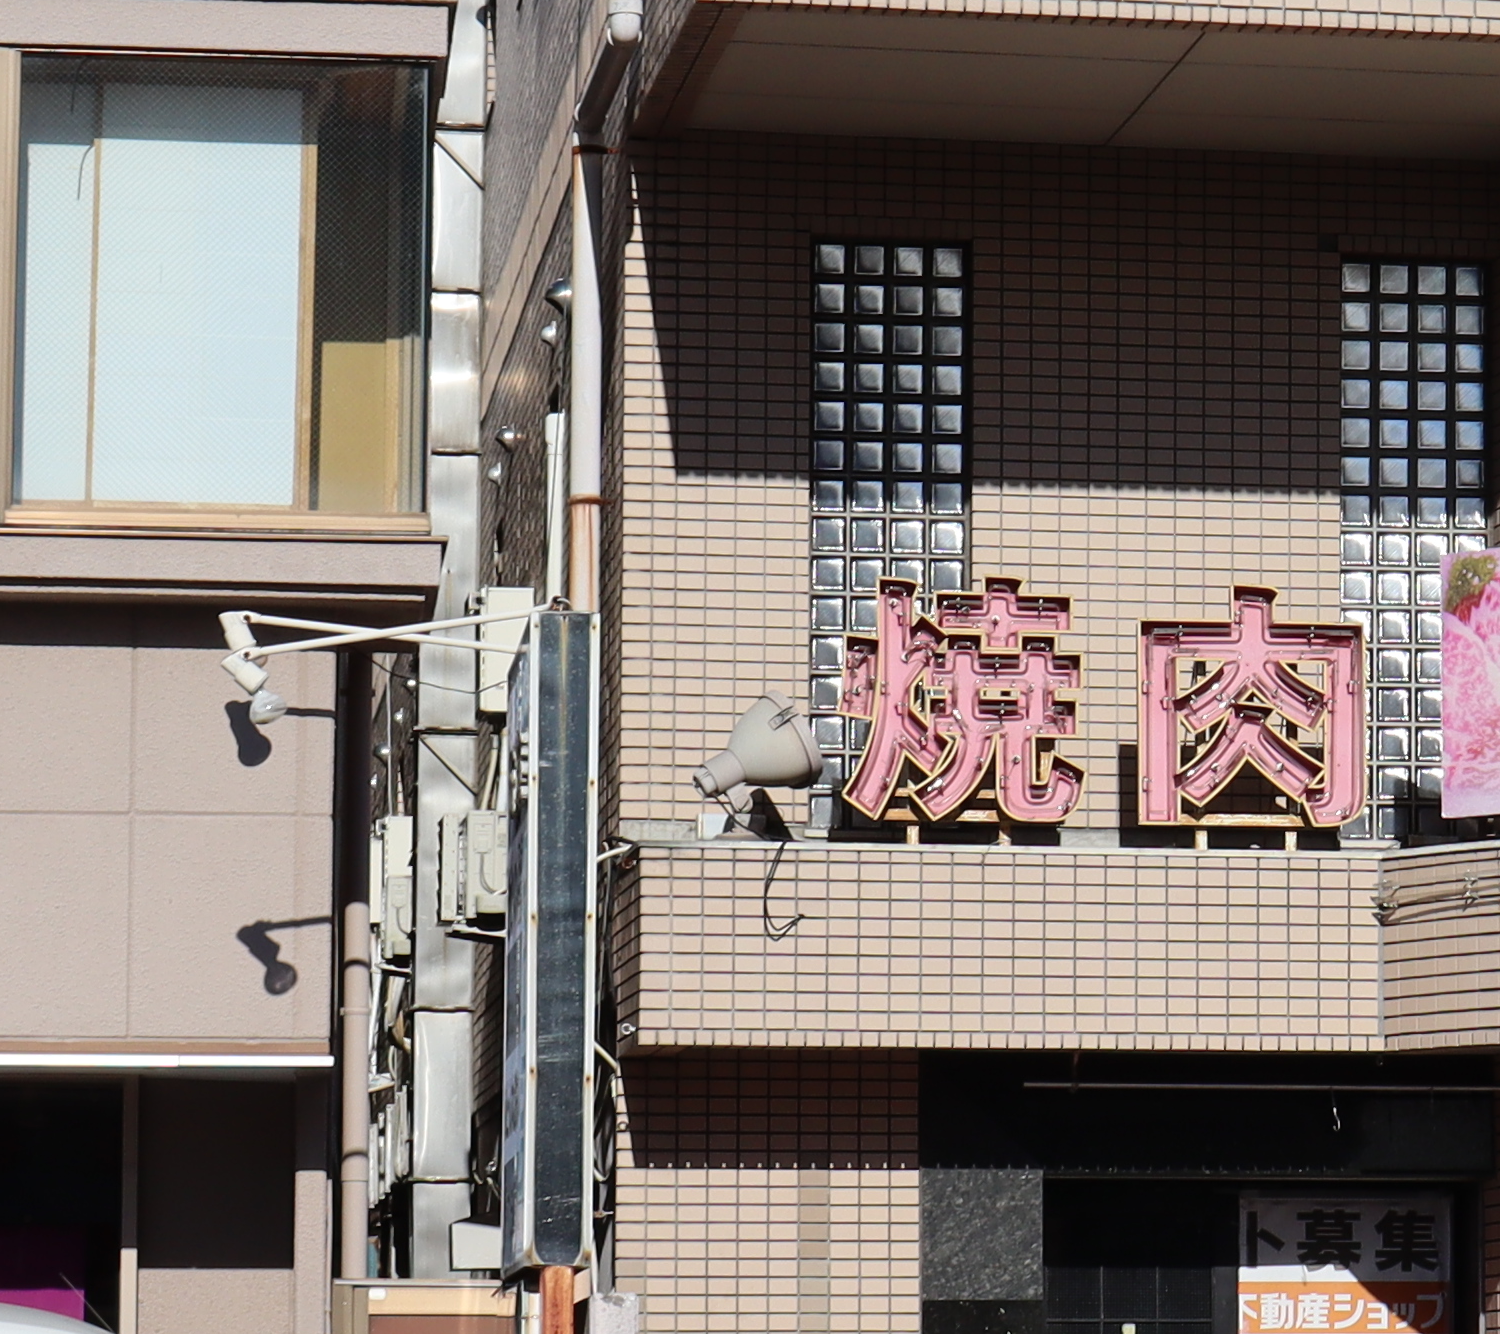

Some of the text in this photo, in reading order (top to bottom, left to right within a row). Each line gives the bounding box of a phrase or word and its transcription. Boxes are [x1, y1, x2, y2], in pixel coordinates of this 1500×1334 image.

[838, 576, 1368, 828] 焼肉
[1246, 1209, 1441, 1272] ト募集
